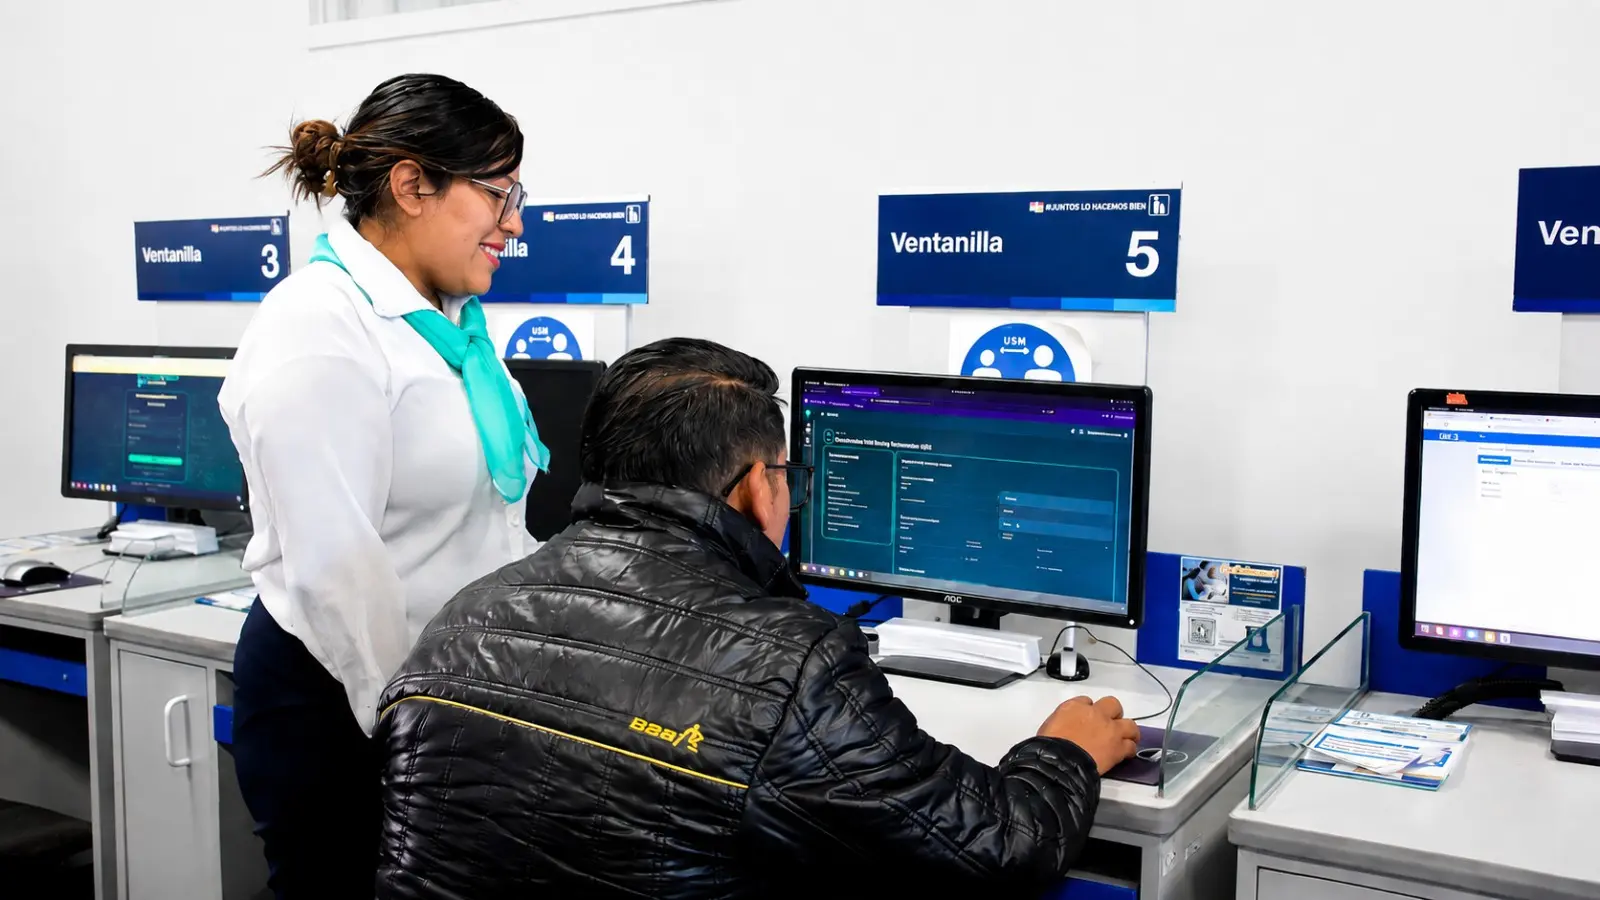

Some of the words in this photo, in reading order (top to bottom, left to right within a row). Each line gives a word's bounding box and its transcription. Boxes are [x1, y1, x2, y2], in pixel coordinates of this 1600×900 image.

[1045, 202, 1080, 212] #JUNTOS
[1081, 202, 1091, 211] LO
[1092, 202, 1128, 211] HACEMOS
[1129, 202, 1147, 211] BIEN
[890, 230, 1003, 253] Ventanilla
[141, 245, 202, 263] Ventanilla
[261, 243, 280, 279] 3
[610, 235, 636, 275] 4
[1125, 230, 1160, 278] 5
[1003, 336, 1027, 346] USM
[943, 594, 963, 604] AOC
